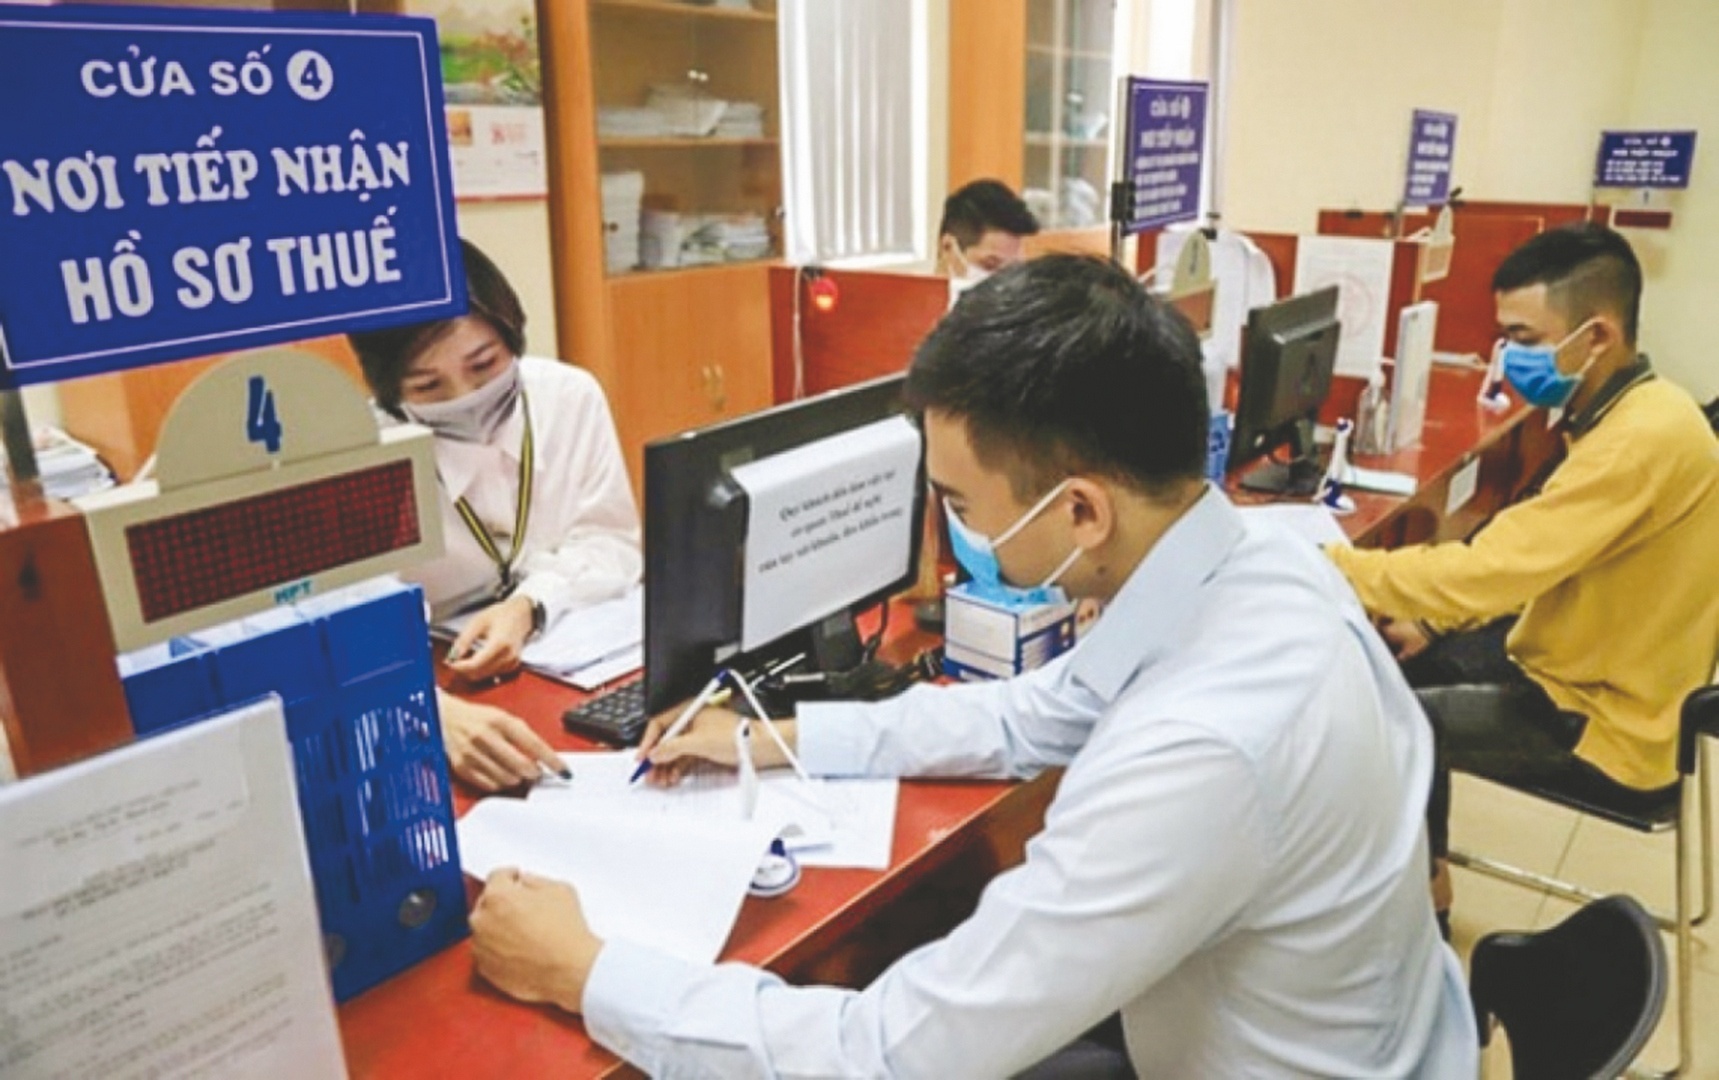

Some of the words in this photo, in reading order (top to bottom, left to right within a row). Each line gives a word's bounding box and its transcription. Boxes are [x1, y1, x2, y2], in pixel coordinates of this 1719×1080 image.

[81, 44, 196, 98] CỬA
[209, 44, 273, 96] SỐ
[2, 150, 124, 216] NƠI
[134, 125, 259, 206] TIẾP
[271, 129, 411, 202] NHẬN
[60, 229, 154, 324] HỒ
[172, 237, 253, 309] SƠ
[266, 204, 402, 296] THUẾ
[247, 375, 282, 453] 4
